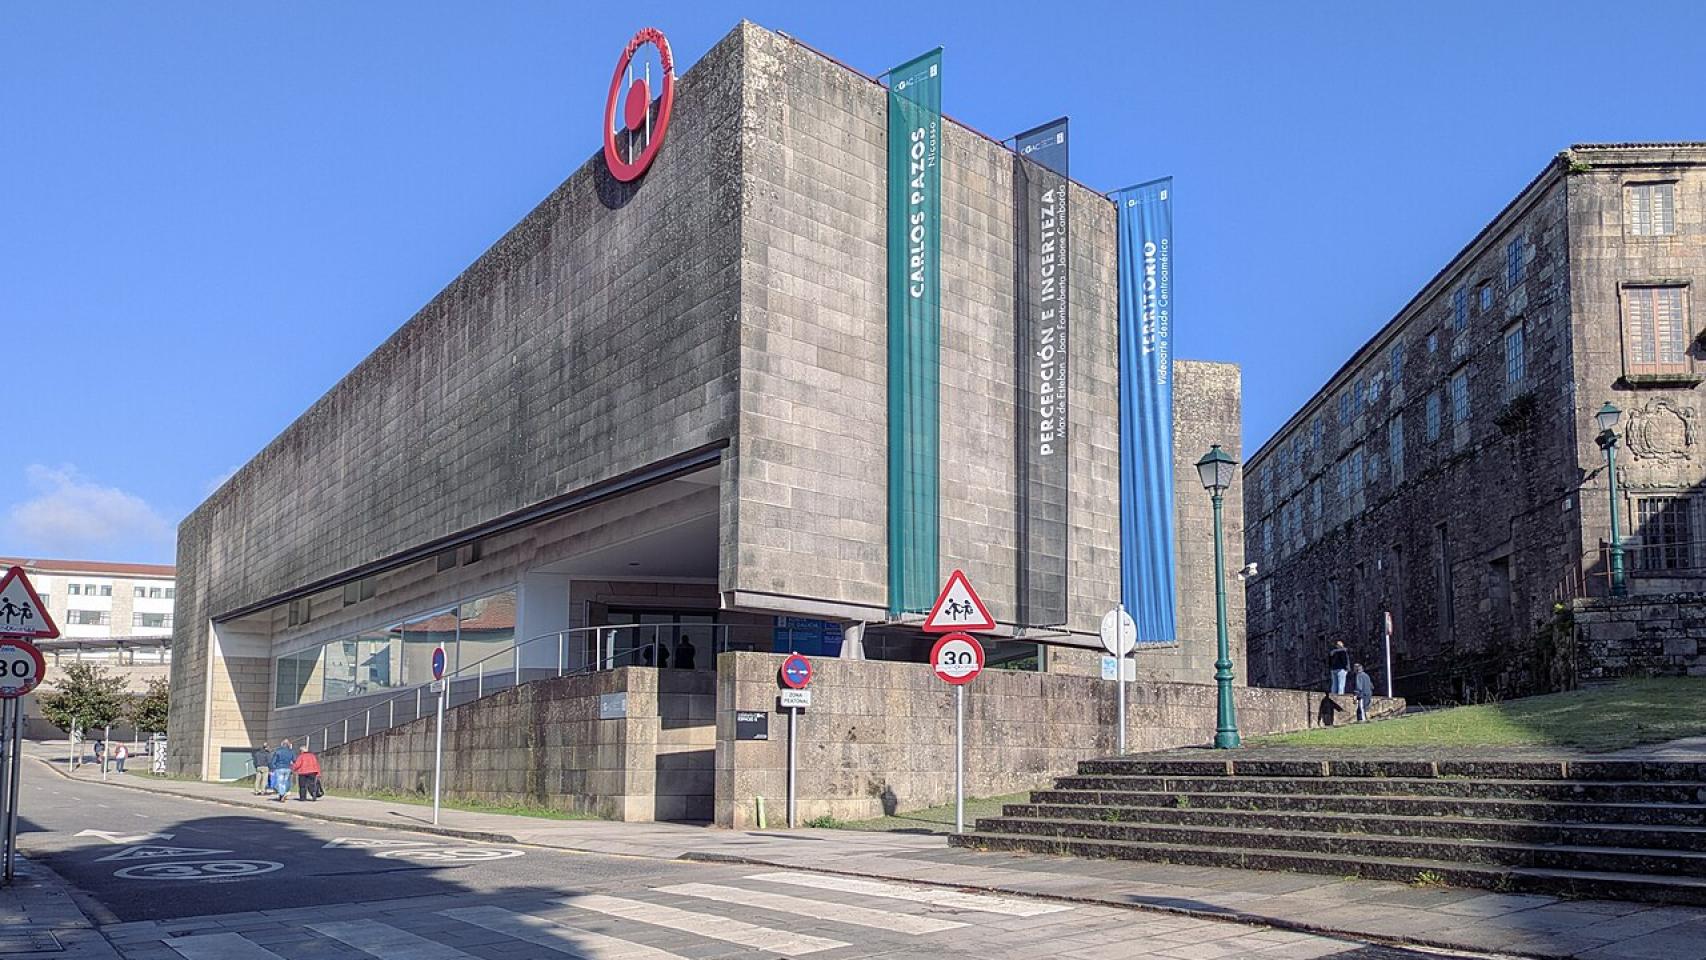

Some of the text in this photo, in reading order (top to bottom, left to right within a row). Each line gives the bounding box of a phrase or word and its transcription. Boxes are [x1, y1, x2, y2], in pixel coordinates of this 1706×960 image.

[928, 122, 937, 168] Nicasso
[909, 127, 926, 298] CARLOS PAZOS
[1056, 276, 1066, 330] Fontcuberta
[1142, 241, 1157, 356] TERRITORIO
[1157, 239, 1168, 385] Videoarte desde Centroamérica
[1036, 188, 1055, 456] PERCEPCIÓN E INCERTEZA
[1056, 332, 1066, 354] Joan
[1056, 363, 1066, 398] Esteban
[1056, 401, 1066, 414] de
[1056, 416, 1066, 438] Max
[944, 651, 972, 665] 30
[143, 863, 260, 877] 30
